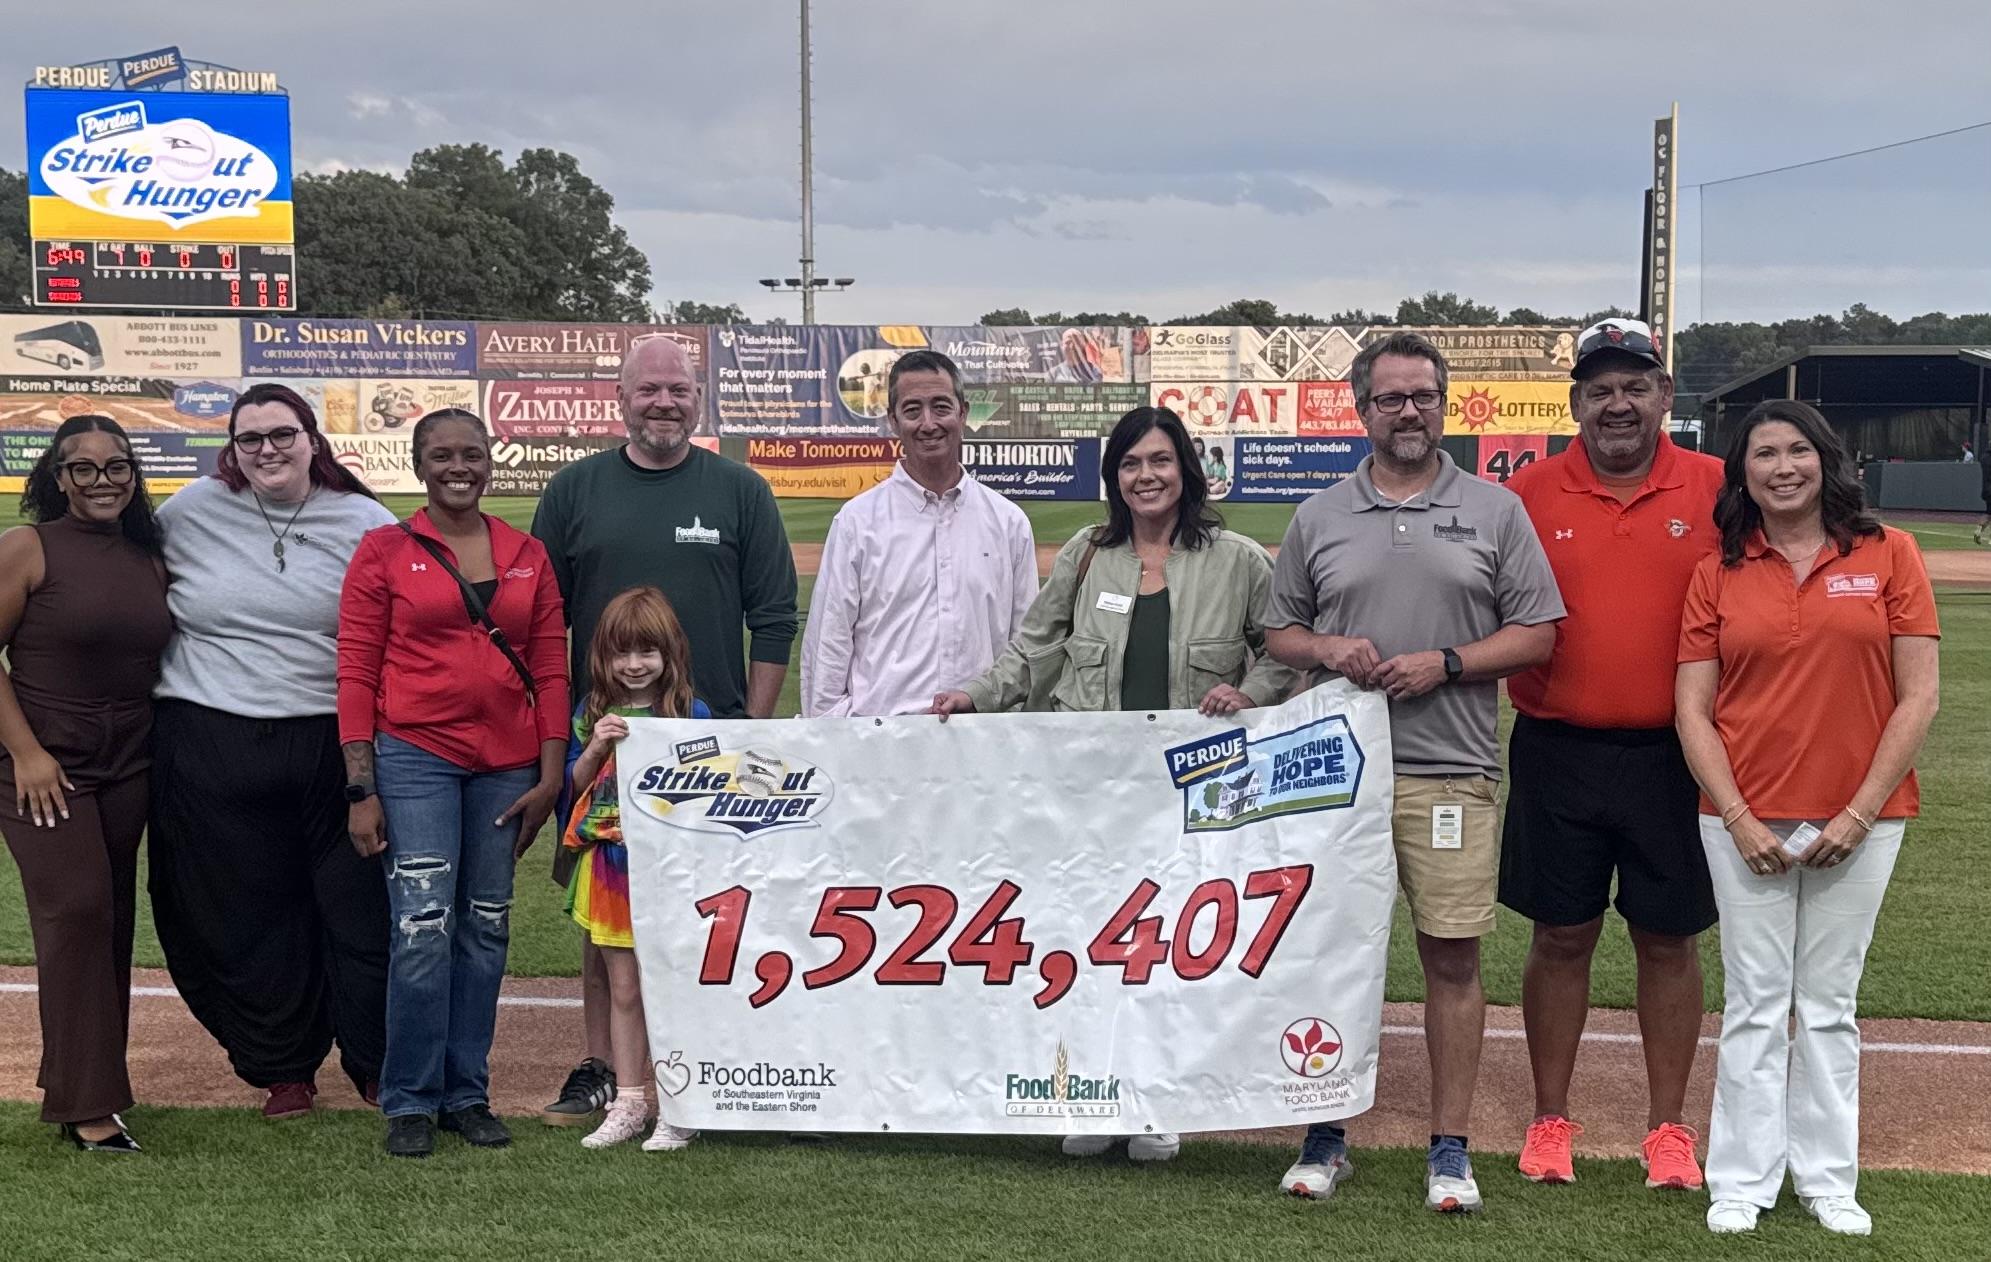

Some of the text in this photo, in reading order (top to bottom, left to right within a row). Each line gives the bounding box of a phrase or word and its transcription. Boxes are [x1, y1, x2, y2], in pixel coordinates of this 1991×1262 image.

[123, 54, 176, 77] PERDUE
[36, 66, 277, 91] PERDUE STADIUM
[85, 109, 140, 136] Perdue
[47, 148, 152, 174] Strike
[122, 180, 262, 214] Hunger
[127, 322, 218, 331] ABBOTT BUS LINES
[253, 322, 467, 345] Dr. Susan Vickers
[485, 330, 556, 352] AVERY
[561, 330, 621, 353] HALL
[1175, 333, 1232, 346] GoGlass
[1459, 335, 1546, 348] PROSTHETICS
[262, 350, 338, 359] ORTHODONTICS
[351, 350, 400, 360] PEDIATRIC
[403, 351, 457, 360] DENTISTRY
[174, 362, 198, 371] 1927
[719, 367, 827, 381] For every moment
[9, 380, 141, 394] Home Plate Special
[534, 386, 586, 395] JOSEPH M.
[719, 382, 793, 393] that matters
[1307, 388, 1335, 398] PEERS
[180, 390, 230, 404] Hampton
[1305, 398, 1356, 408] AVAILABL
[498, 391, 623, 421] ZIMMER
[1320, 407, 1343, 417] 24/7
[1498, 402, 1566, 417] LOTTERY
[513, 425, 534, 434] INC.
[3, 436, 27, 446] THE
[1243, 442, 1351, 453] Life doesn't schedule
[4, 448, 20, 458] TO
[750, 440, 796, 458] Make
[800, 440, 885, 458] Tomorrow
[366, 457, 413, 471] BANK
[1243, 454, 1292, 466] sick days.
[492, 470, 557, 479] RENOVATIN
[1024, 469, 1074, 484] Builder
[492, 481, 540, 490] FOR THE
[679, 739, 717, 754] PERDUE
[1174, 737, 1245, 771] PERDUE
[637, 765, 731, 791] Strike
[1271, 754, 1346, 788] HOPE
[1292, 775, 1346, 791] NEIGHBORS
[705, 792, 817, 824] Hunger
[695, 864, 1314, 1008] 1,524,407
[698, 1062, 836, 1087] Foodbank
[1006, 1073, 1121, 1100] Food Bank
[1283, 1077, 1349, 1093] MARYLAND
[712, 1089, 821, 1100] of Southeastern Virginia
[1285, 1090, 1350, 1105] FOOD BANK
[716, 1102, 817, 1112] and the Eastern Shore
[1010, 1106, 1116, 1114] OF DELAWARE
